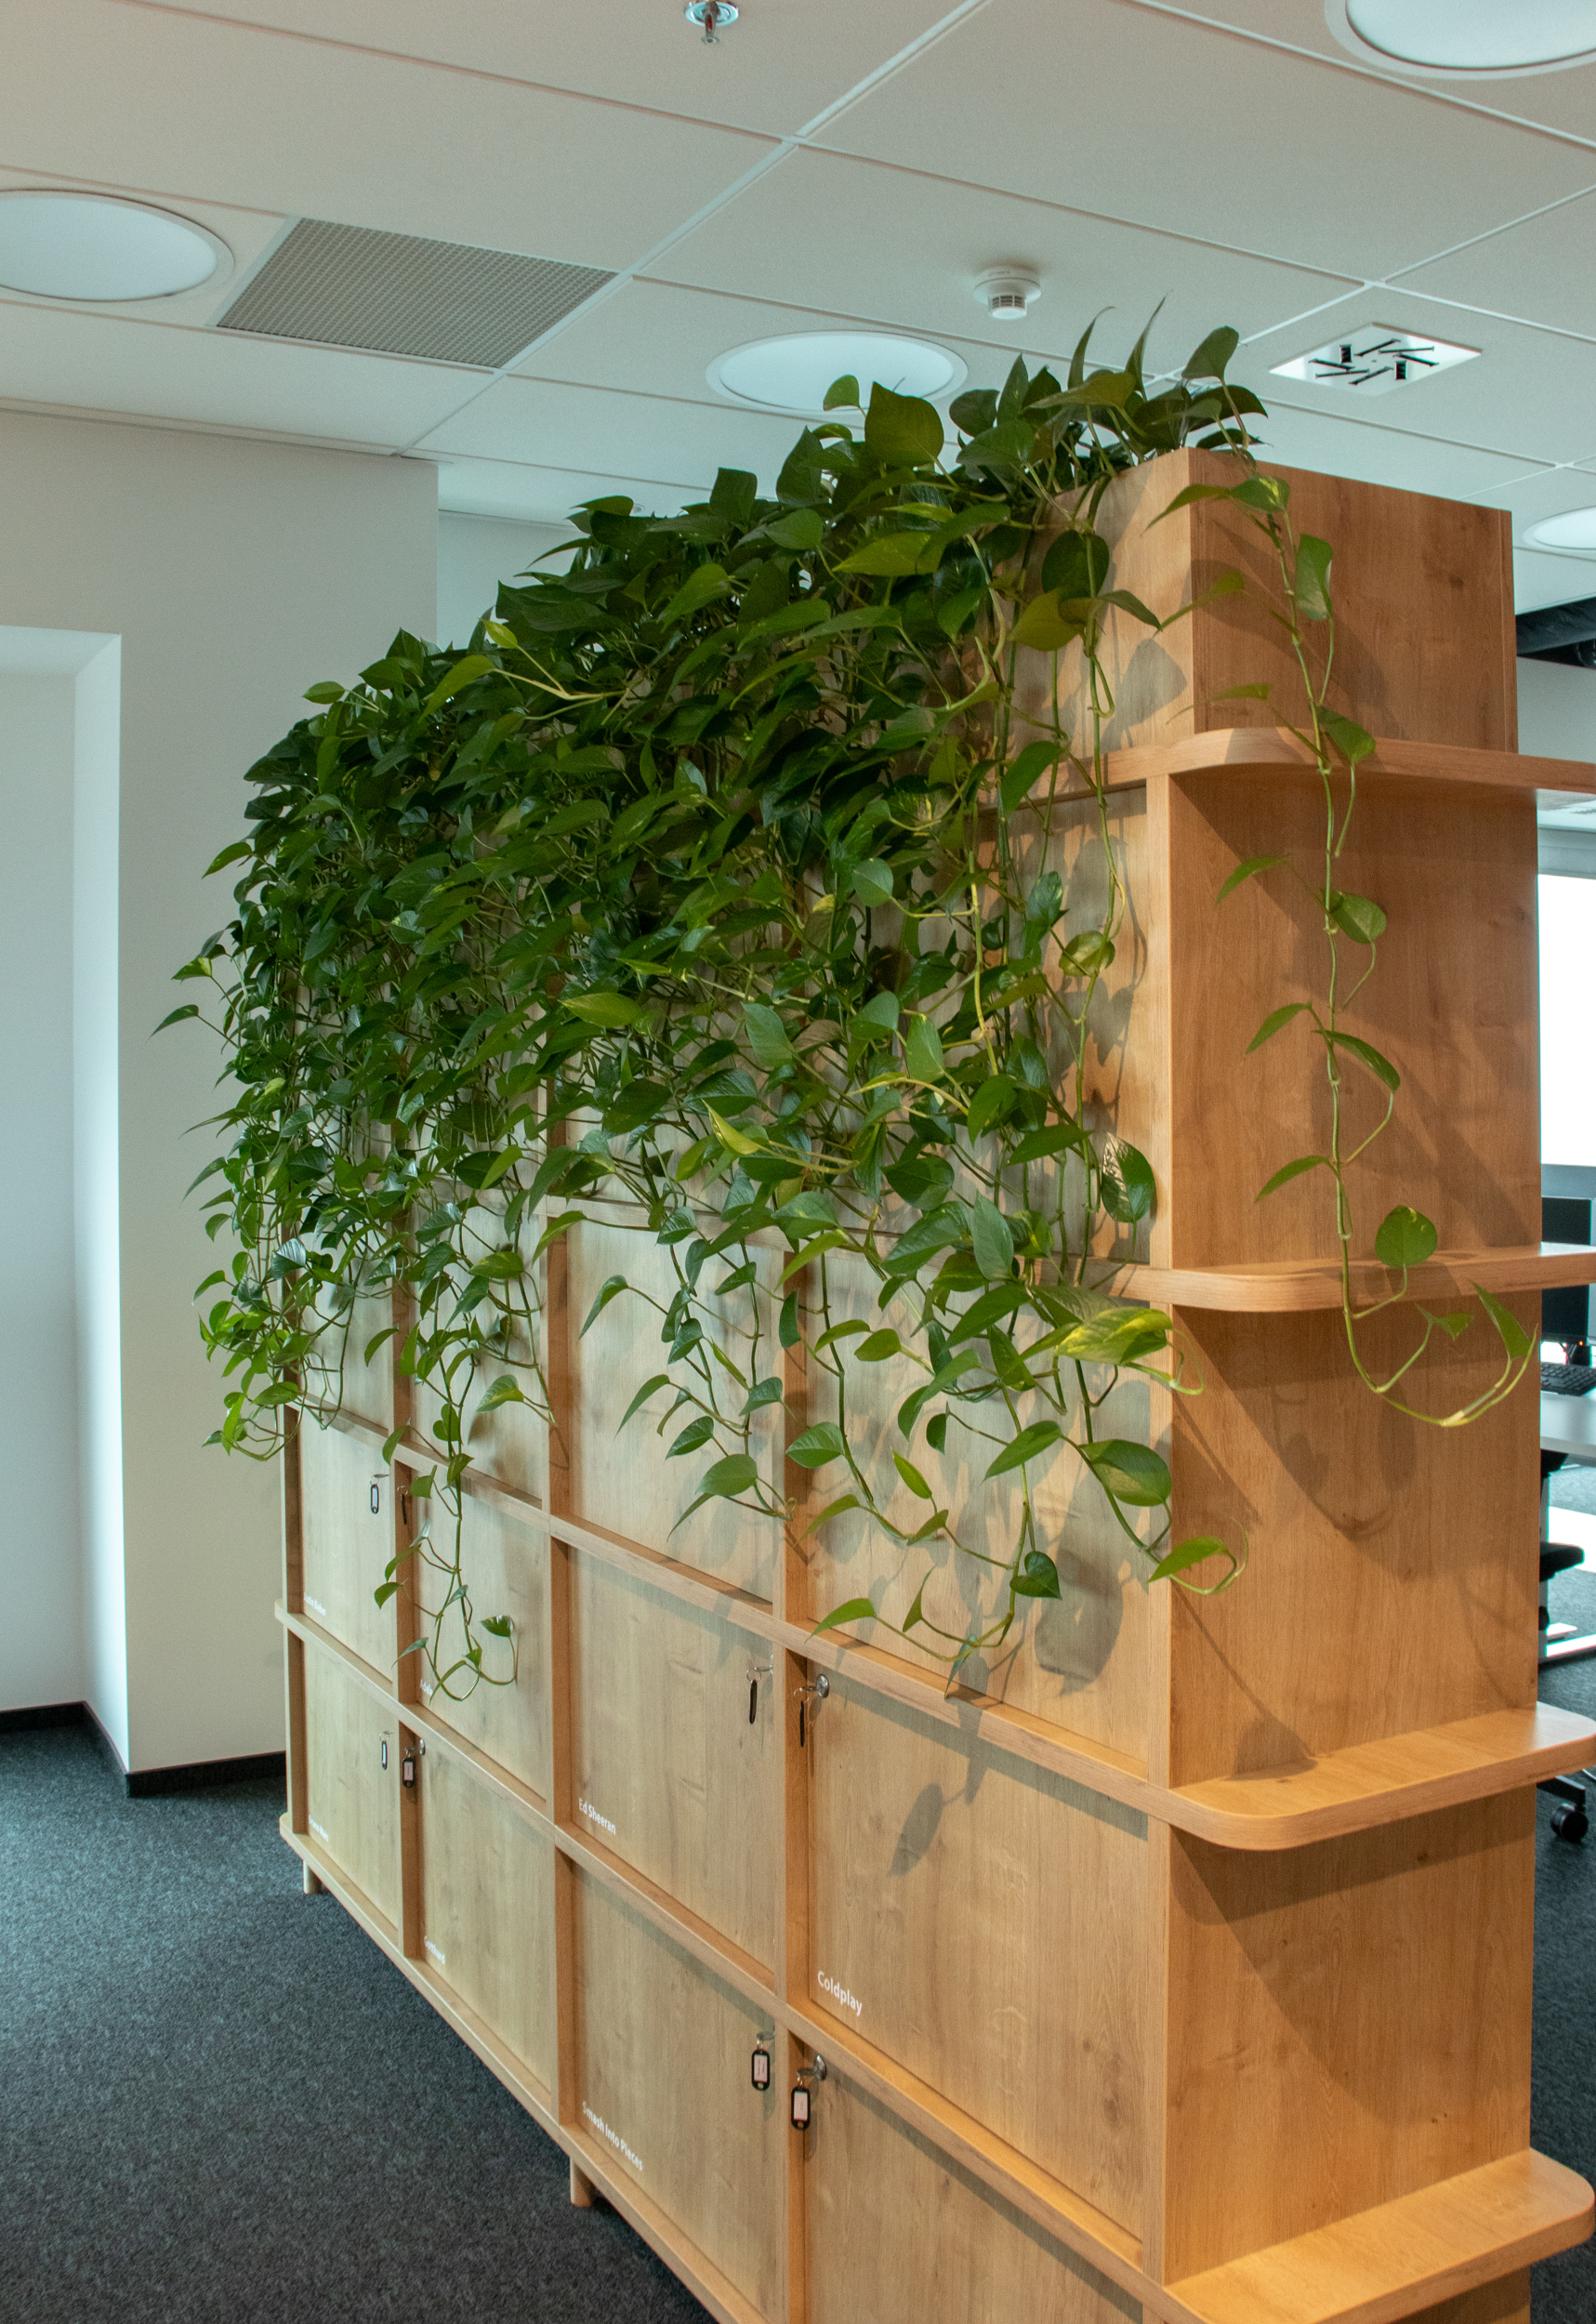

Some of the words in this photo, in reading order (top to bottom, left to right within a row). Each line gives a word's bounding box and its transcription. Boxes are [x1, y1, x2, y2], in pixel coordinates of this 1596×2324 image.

[578, 1797, 587, 1815] Ed
[588, 1804, 616, 1836] Sheeran
[817, 1970, 863, 2017] Coldplay
[582, 2101, 604, 2133] Smash
[605, 2123, 620, 2148] Into
[621, 2138, 643, 2172] Pieces
